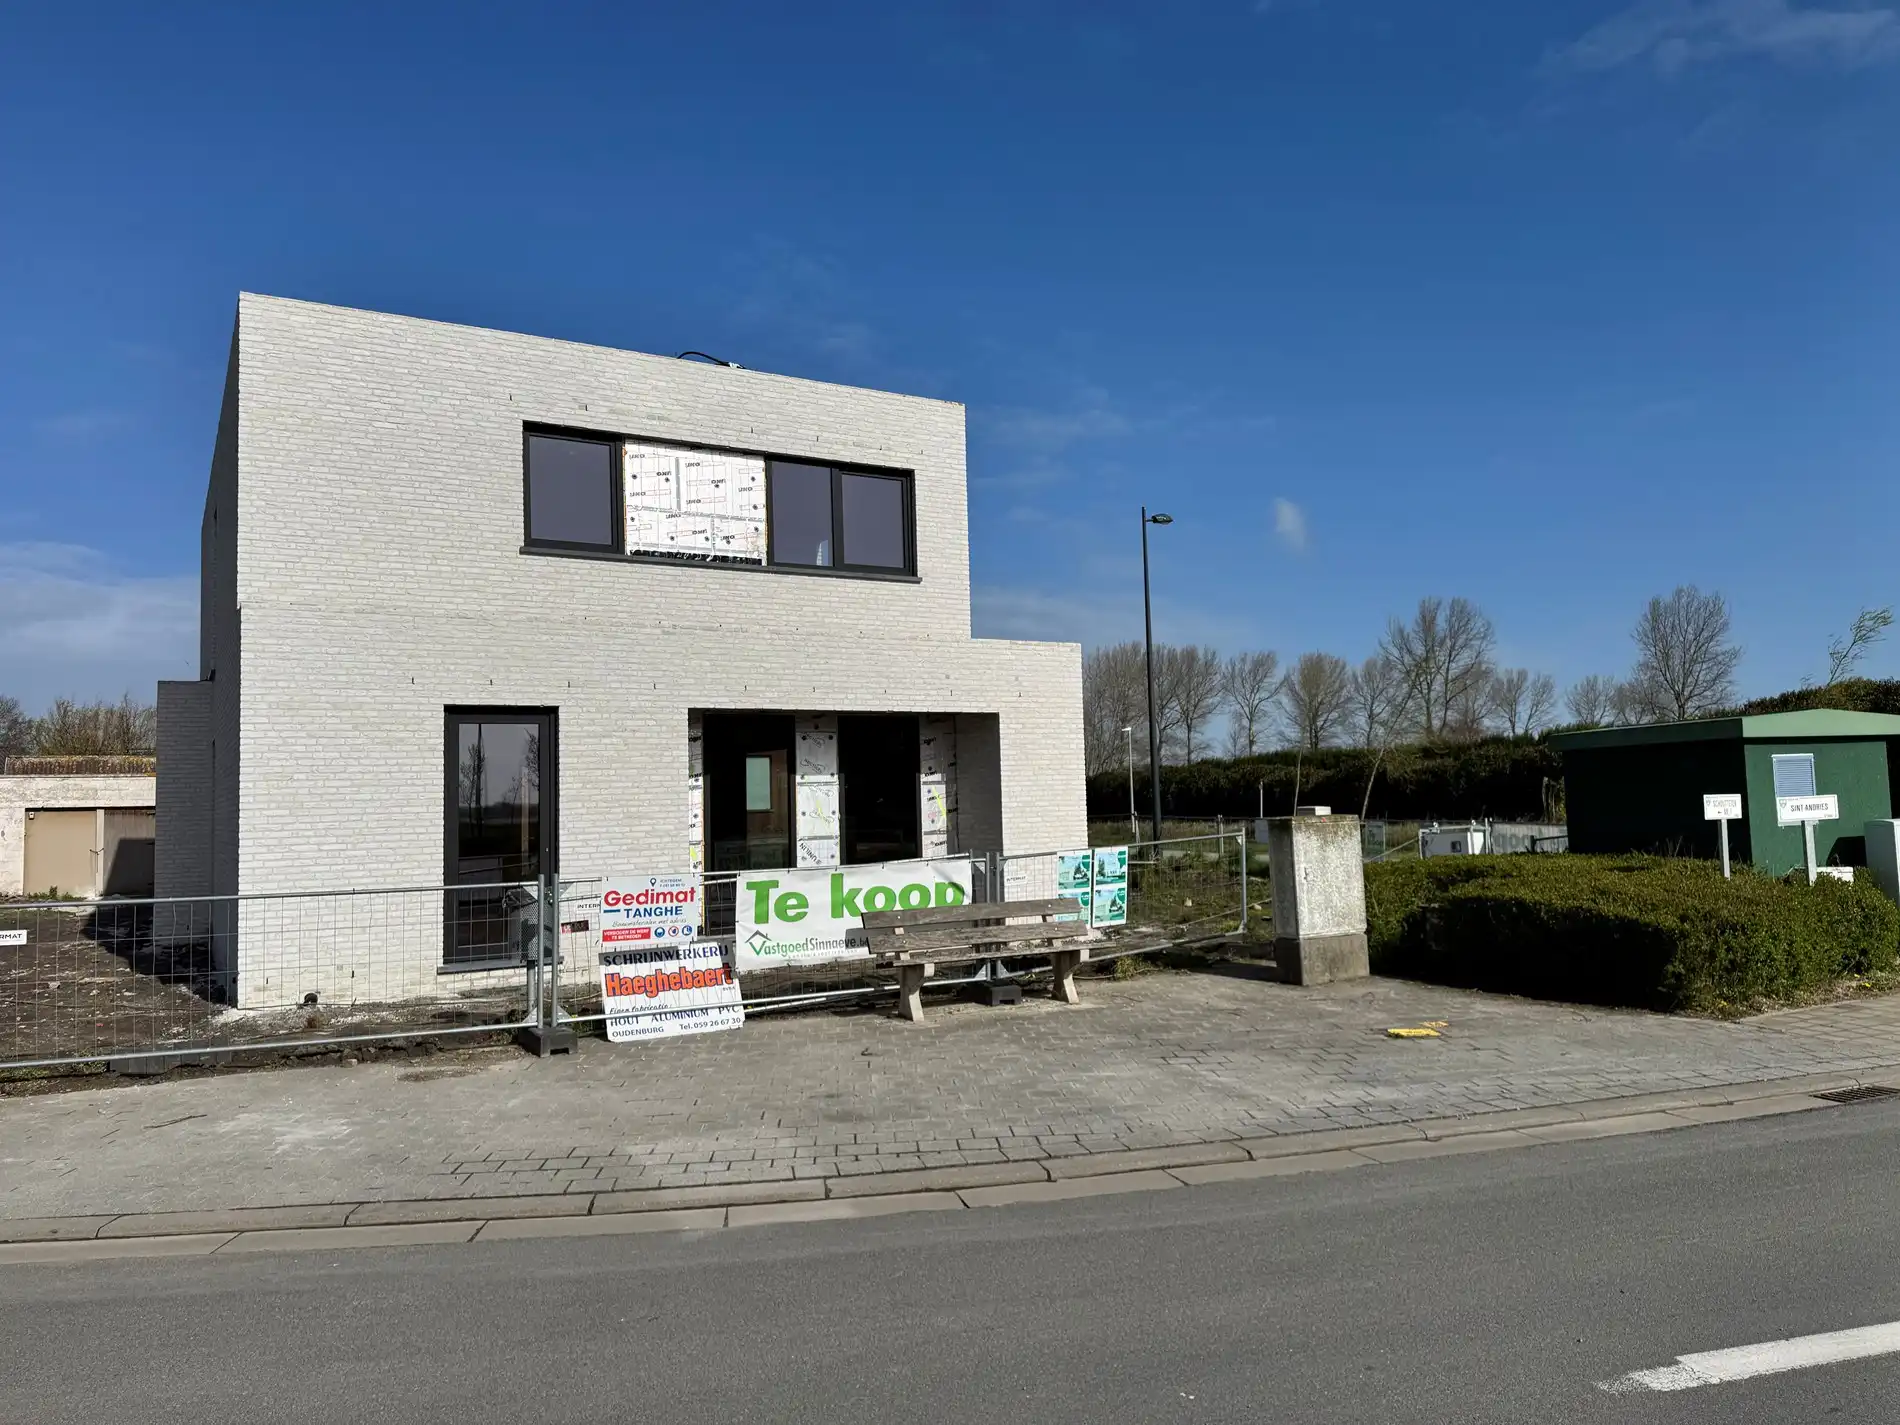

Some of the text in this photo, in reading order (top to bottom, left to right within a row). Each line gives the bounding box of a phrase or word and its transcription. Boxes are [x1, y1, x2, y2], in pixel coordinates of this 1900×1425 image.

[1790, 803, 1829, 812] SINT ANDRIES
[603, 886, 696, 907] Gedimat
[746, 872, 965, 925] Te koop
[623, 905, 683, 919] TANGHE
[604, 962, 734, 998] Haeghebaert
[610, 1004, 740, 1028] HOUT ALUMINIUM PVC
[612, 1026, 664, 1038] OUDENBURG
[709, 1019, 720, 1027] 26
[720, 1018, 731, 1026] 67
[731, 1017, 742, 1025] 30
